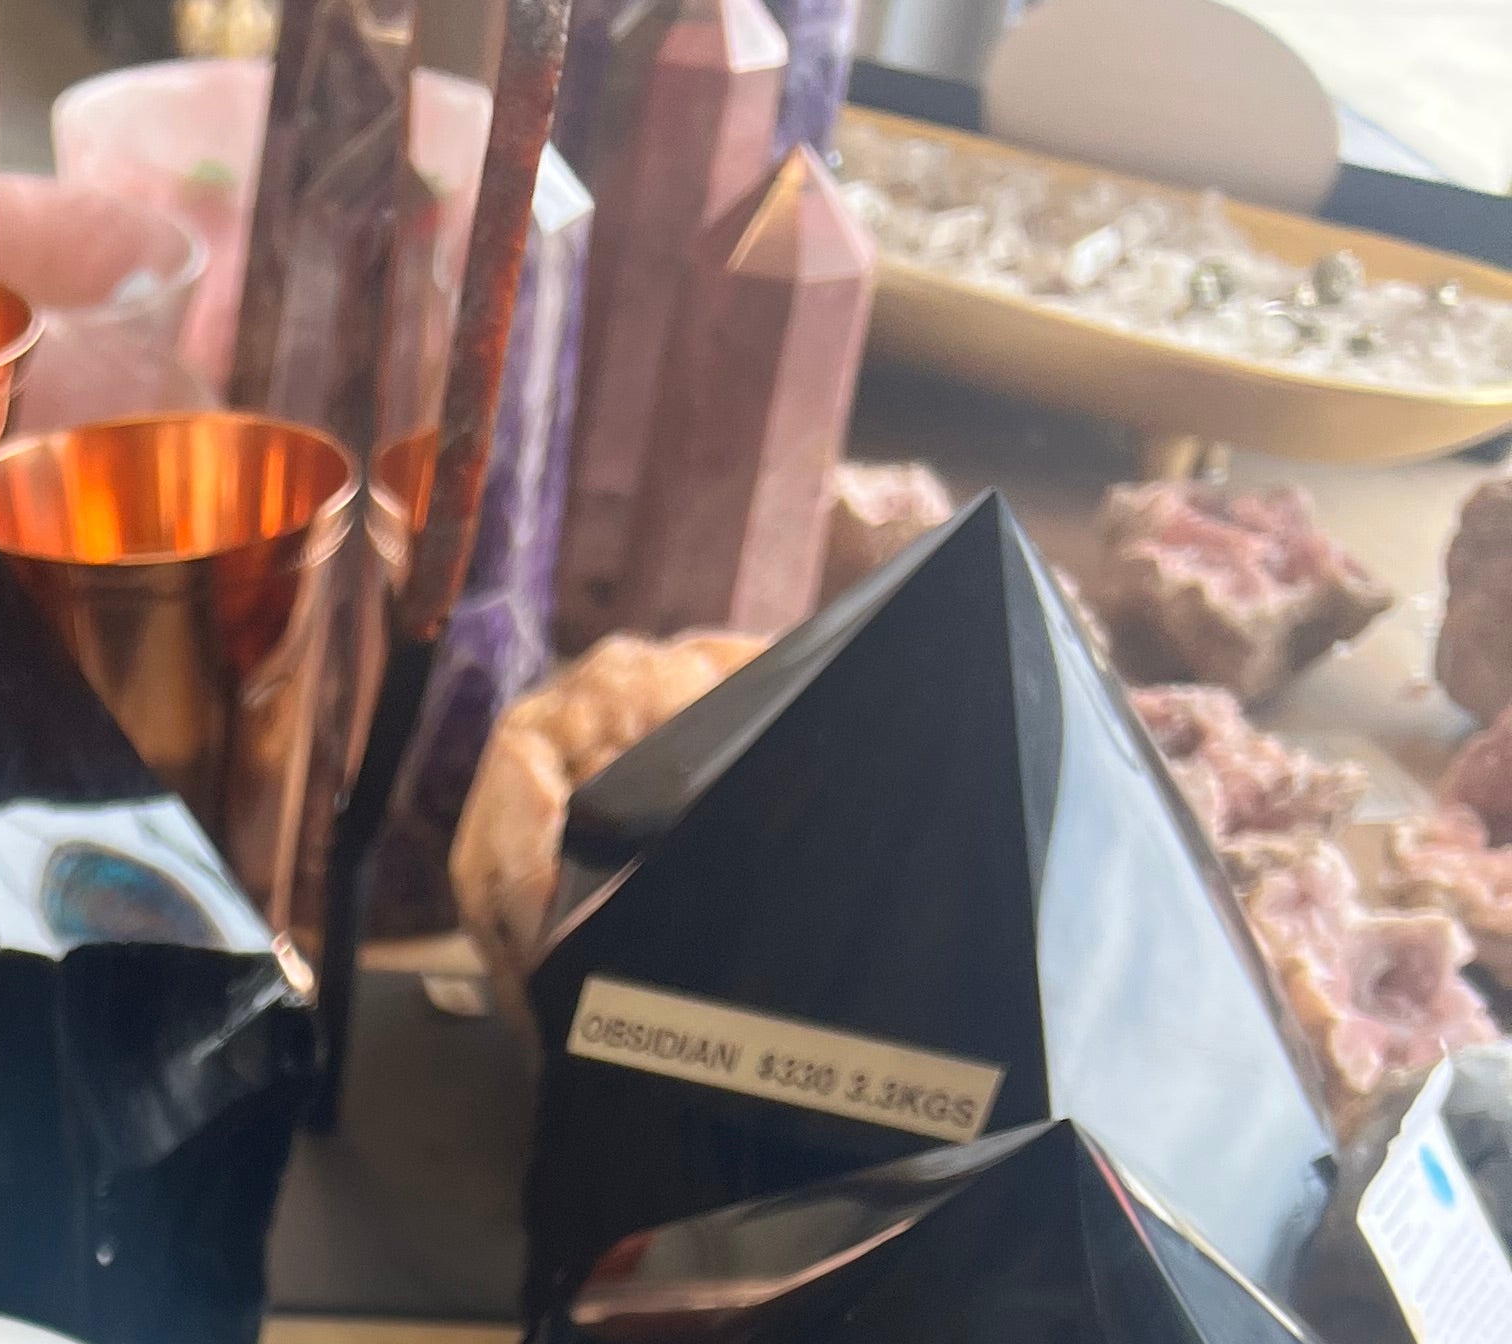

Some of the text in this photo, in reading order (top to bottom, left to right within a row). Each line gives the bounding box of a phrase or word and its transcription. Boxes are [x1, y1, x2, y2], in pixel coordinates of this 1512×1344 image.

[581, 1013, 979, 1129] OBSIDIAN $330 3.3KGS
